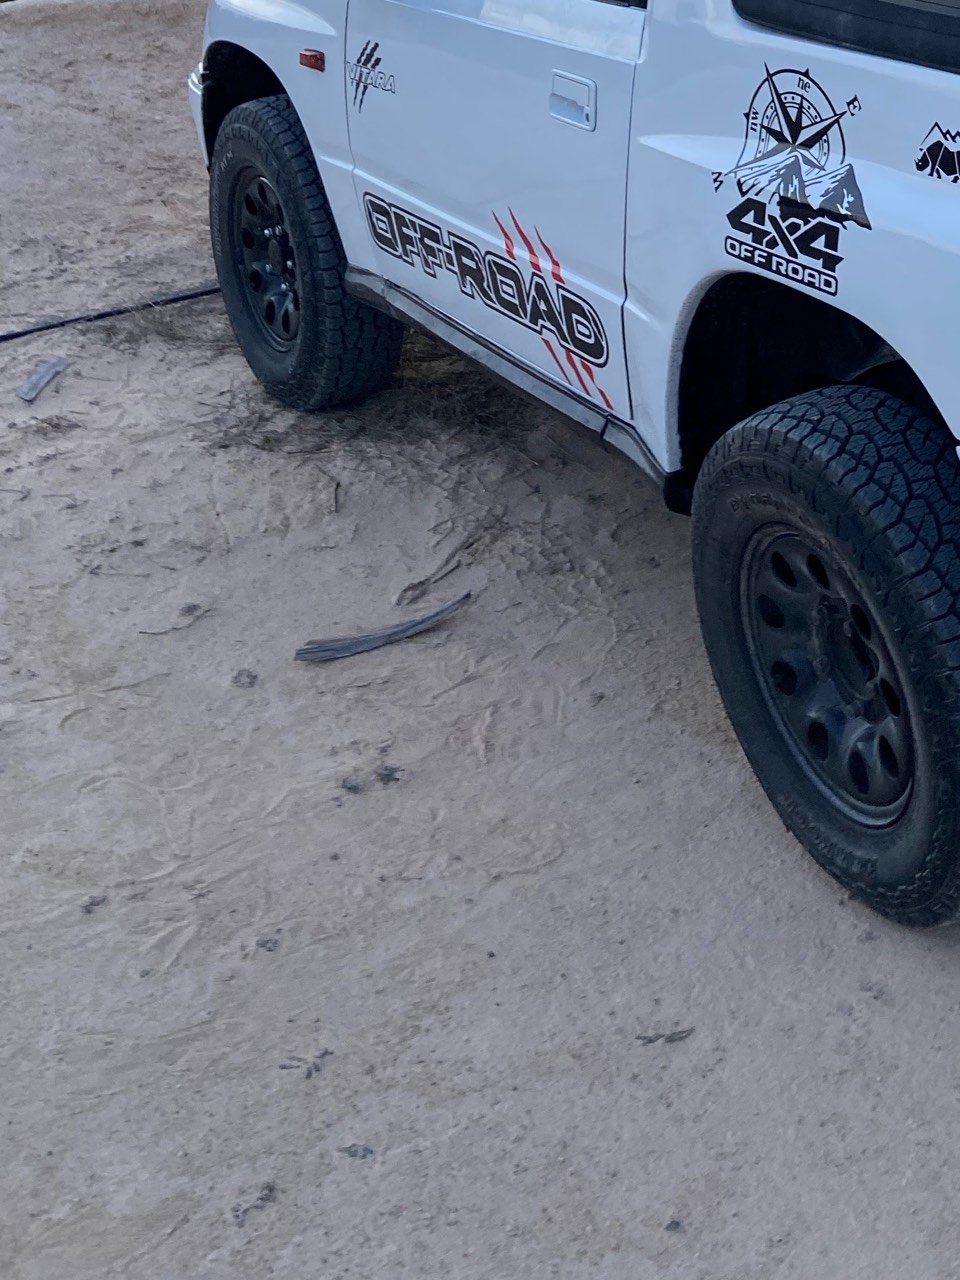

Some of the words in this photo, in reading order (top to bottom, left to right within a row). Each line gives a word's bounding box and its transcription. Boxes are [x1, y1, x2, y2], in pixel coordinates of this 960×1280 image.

[346, 61, 396, 95] VITARA
[797, 76, 811, 94] ne
[363, 191, 609, 368] OFF-ROAD
[726, 239, 768, 265] OFF
[771, 257, 838, 294] ROAD
